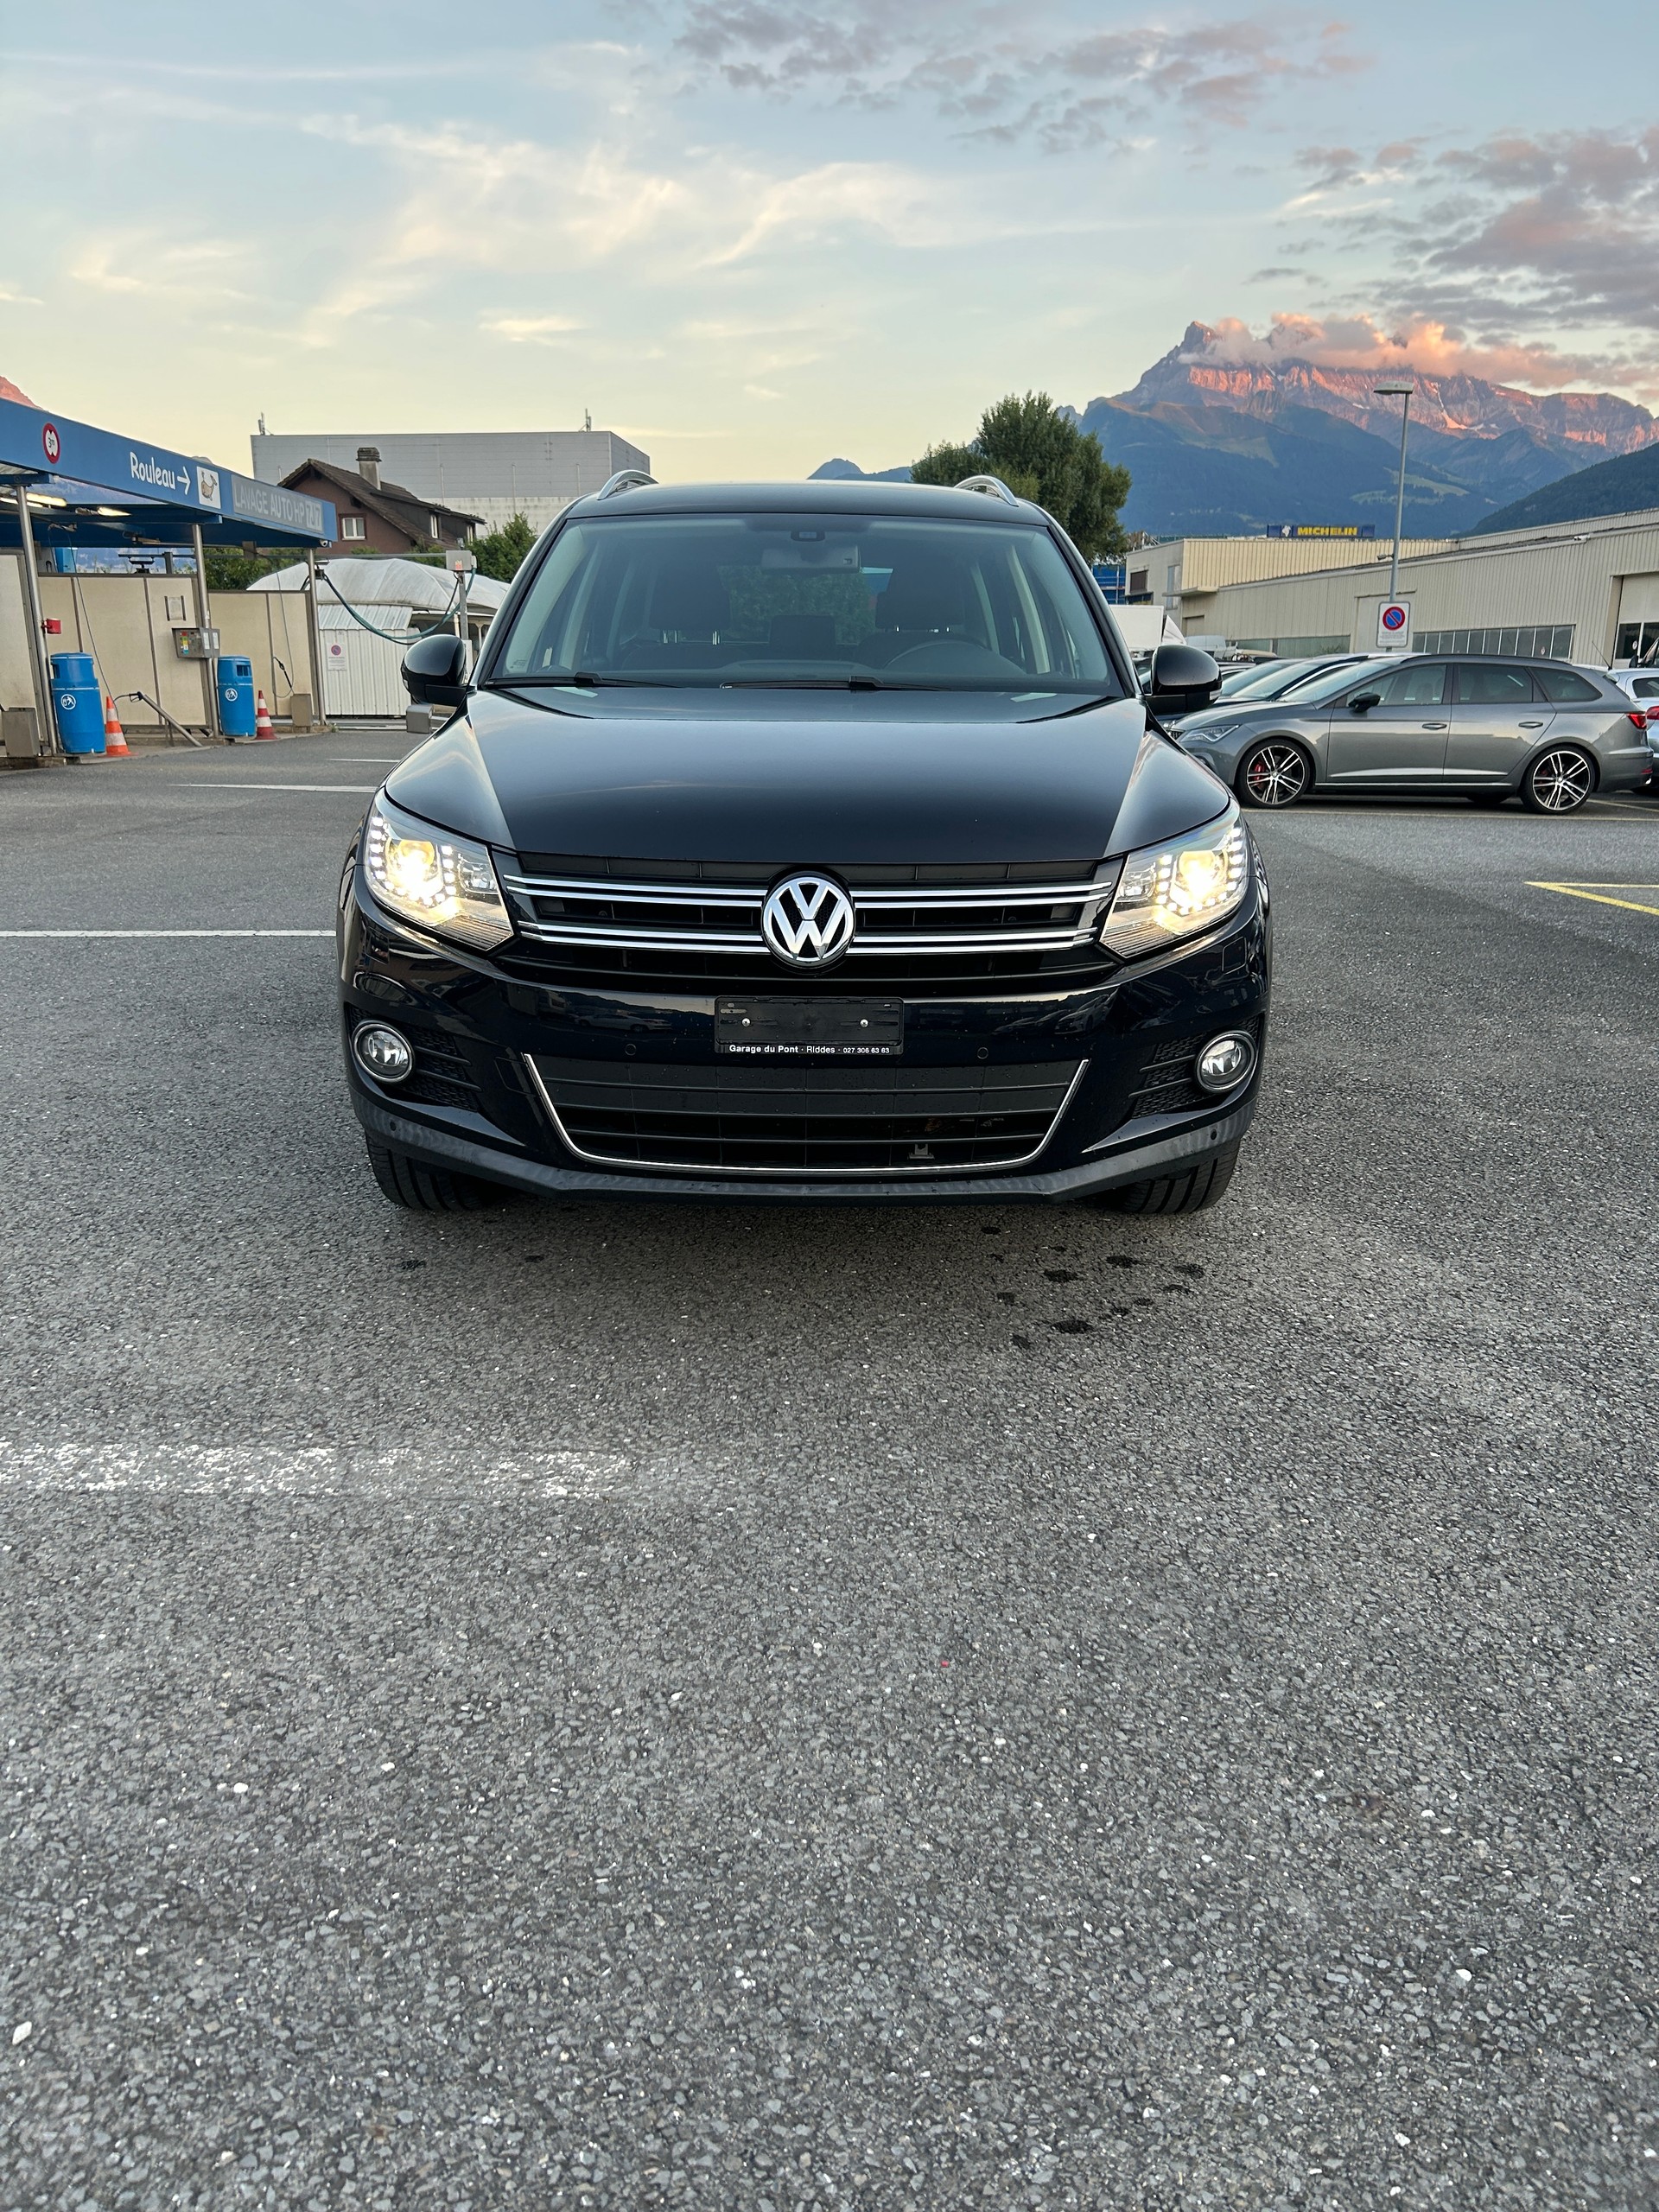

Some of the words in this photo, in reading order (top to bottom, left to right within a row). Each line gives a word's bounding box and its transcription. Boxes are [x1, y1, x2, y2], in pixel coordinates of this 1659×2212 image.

[130, 451, 175, 490] Rouleau
[234, 483, 269, 515] LAVAGE
[270, 493, 294, 521] AUTO
[294, 499, 305, 524] HP
[1297, 526, 1357, 536] MICHELIN
[728, 1044, 761, 1054] Garage
[764, 1045, 775, 1053] du
